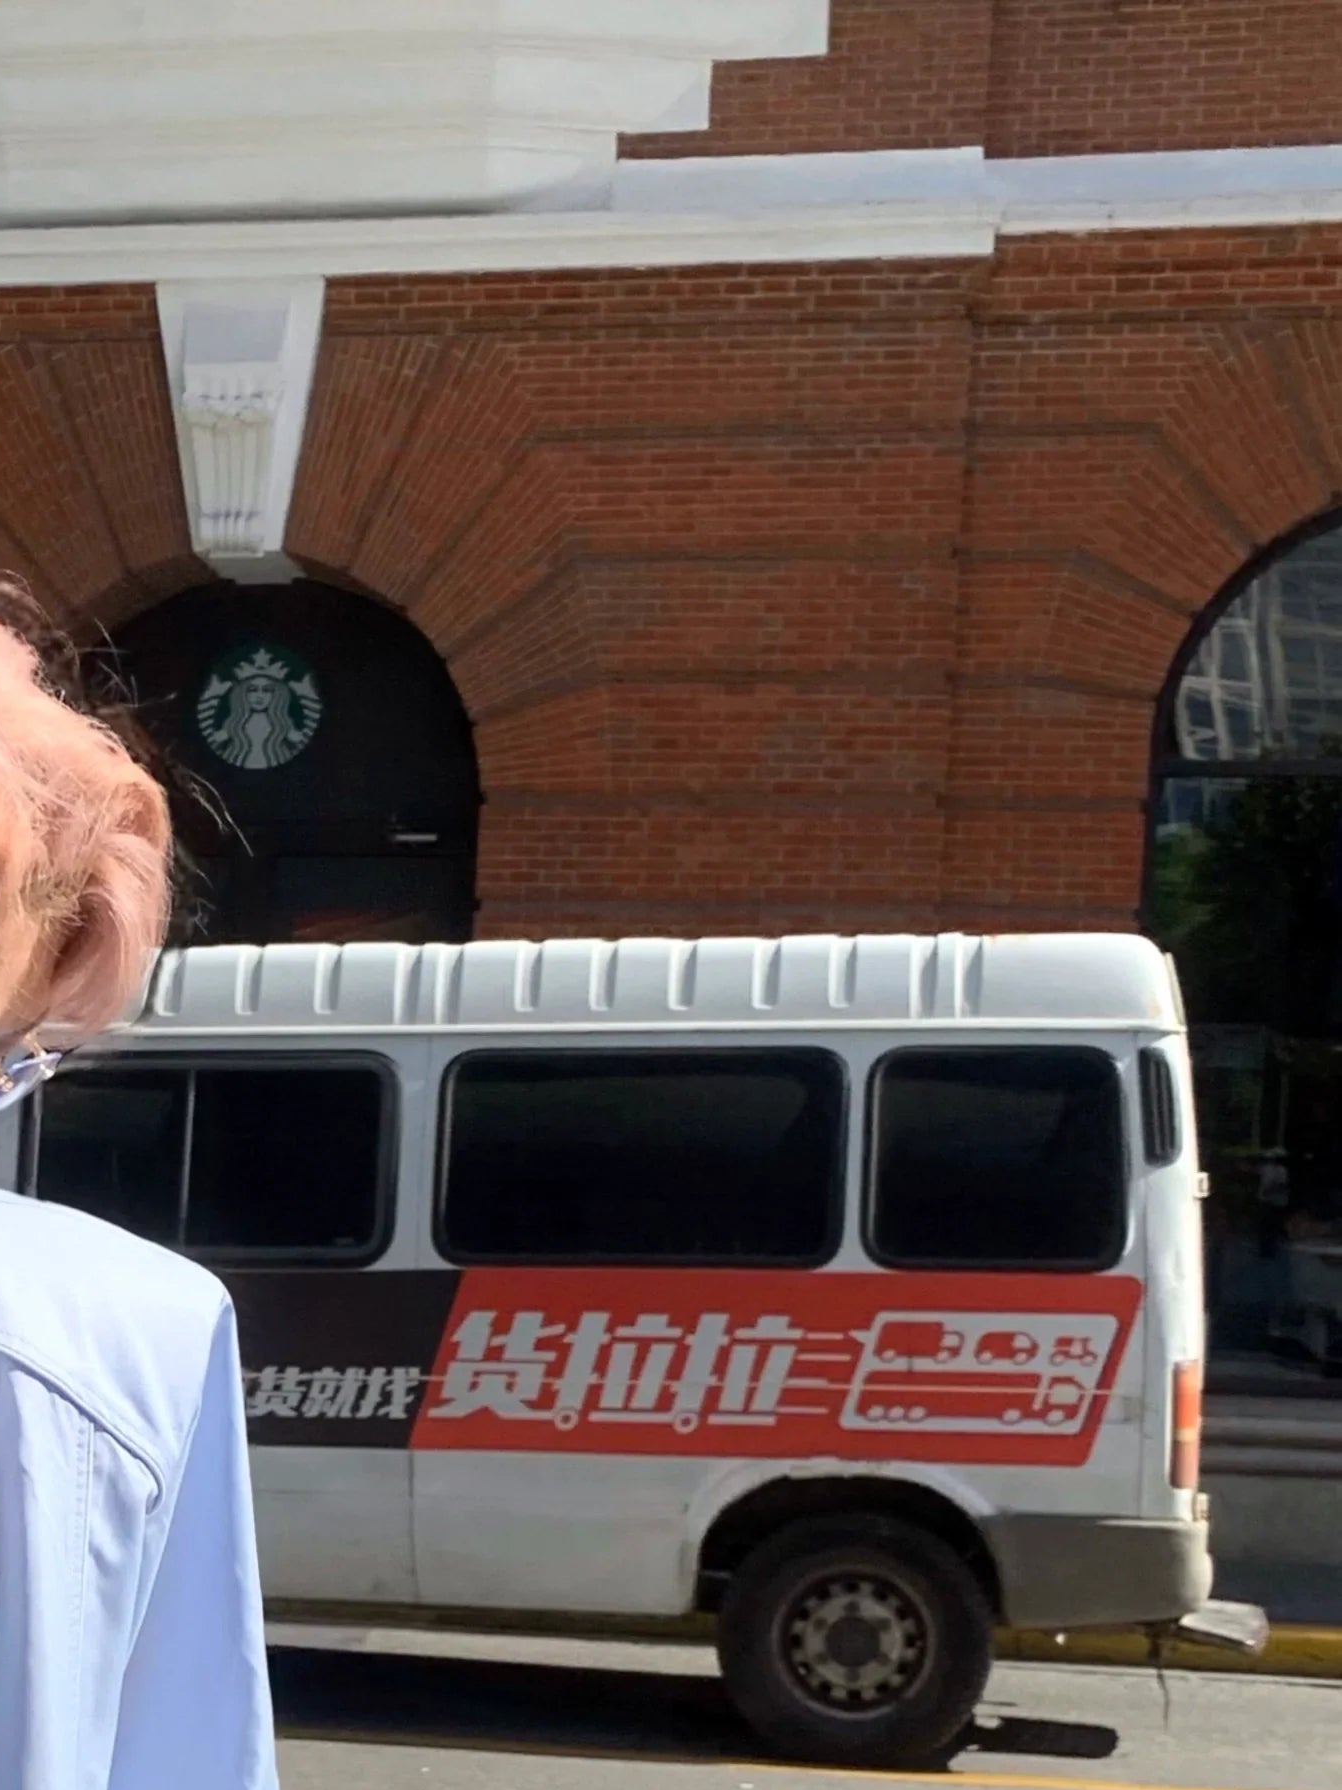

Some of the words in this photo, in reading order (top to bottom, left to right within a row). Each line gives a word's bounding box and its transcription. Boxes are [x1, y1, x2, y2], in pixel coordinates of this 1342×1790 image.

[242, 1365, 421, 1419] 货就找
[427, 1310, 803, 1433] 货拉拉
